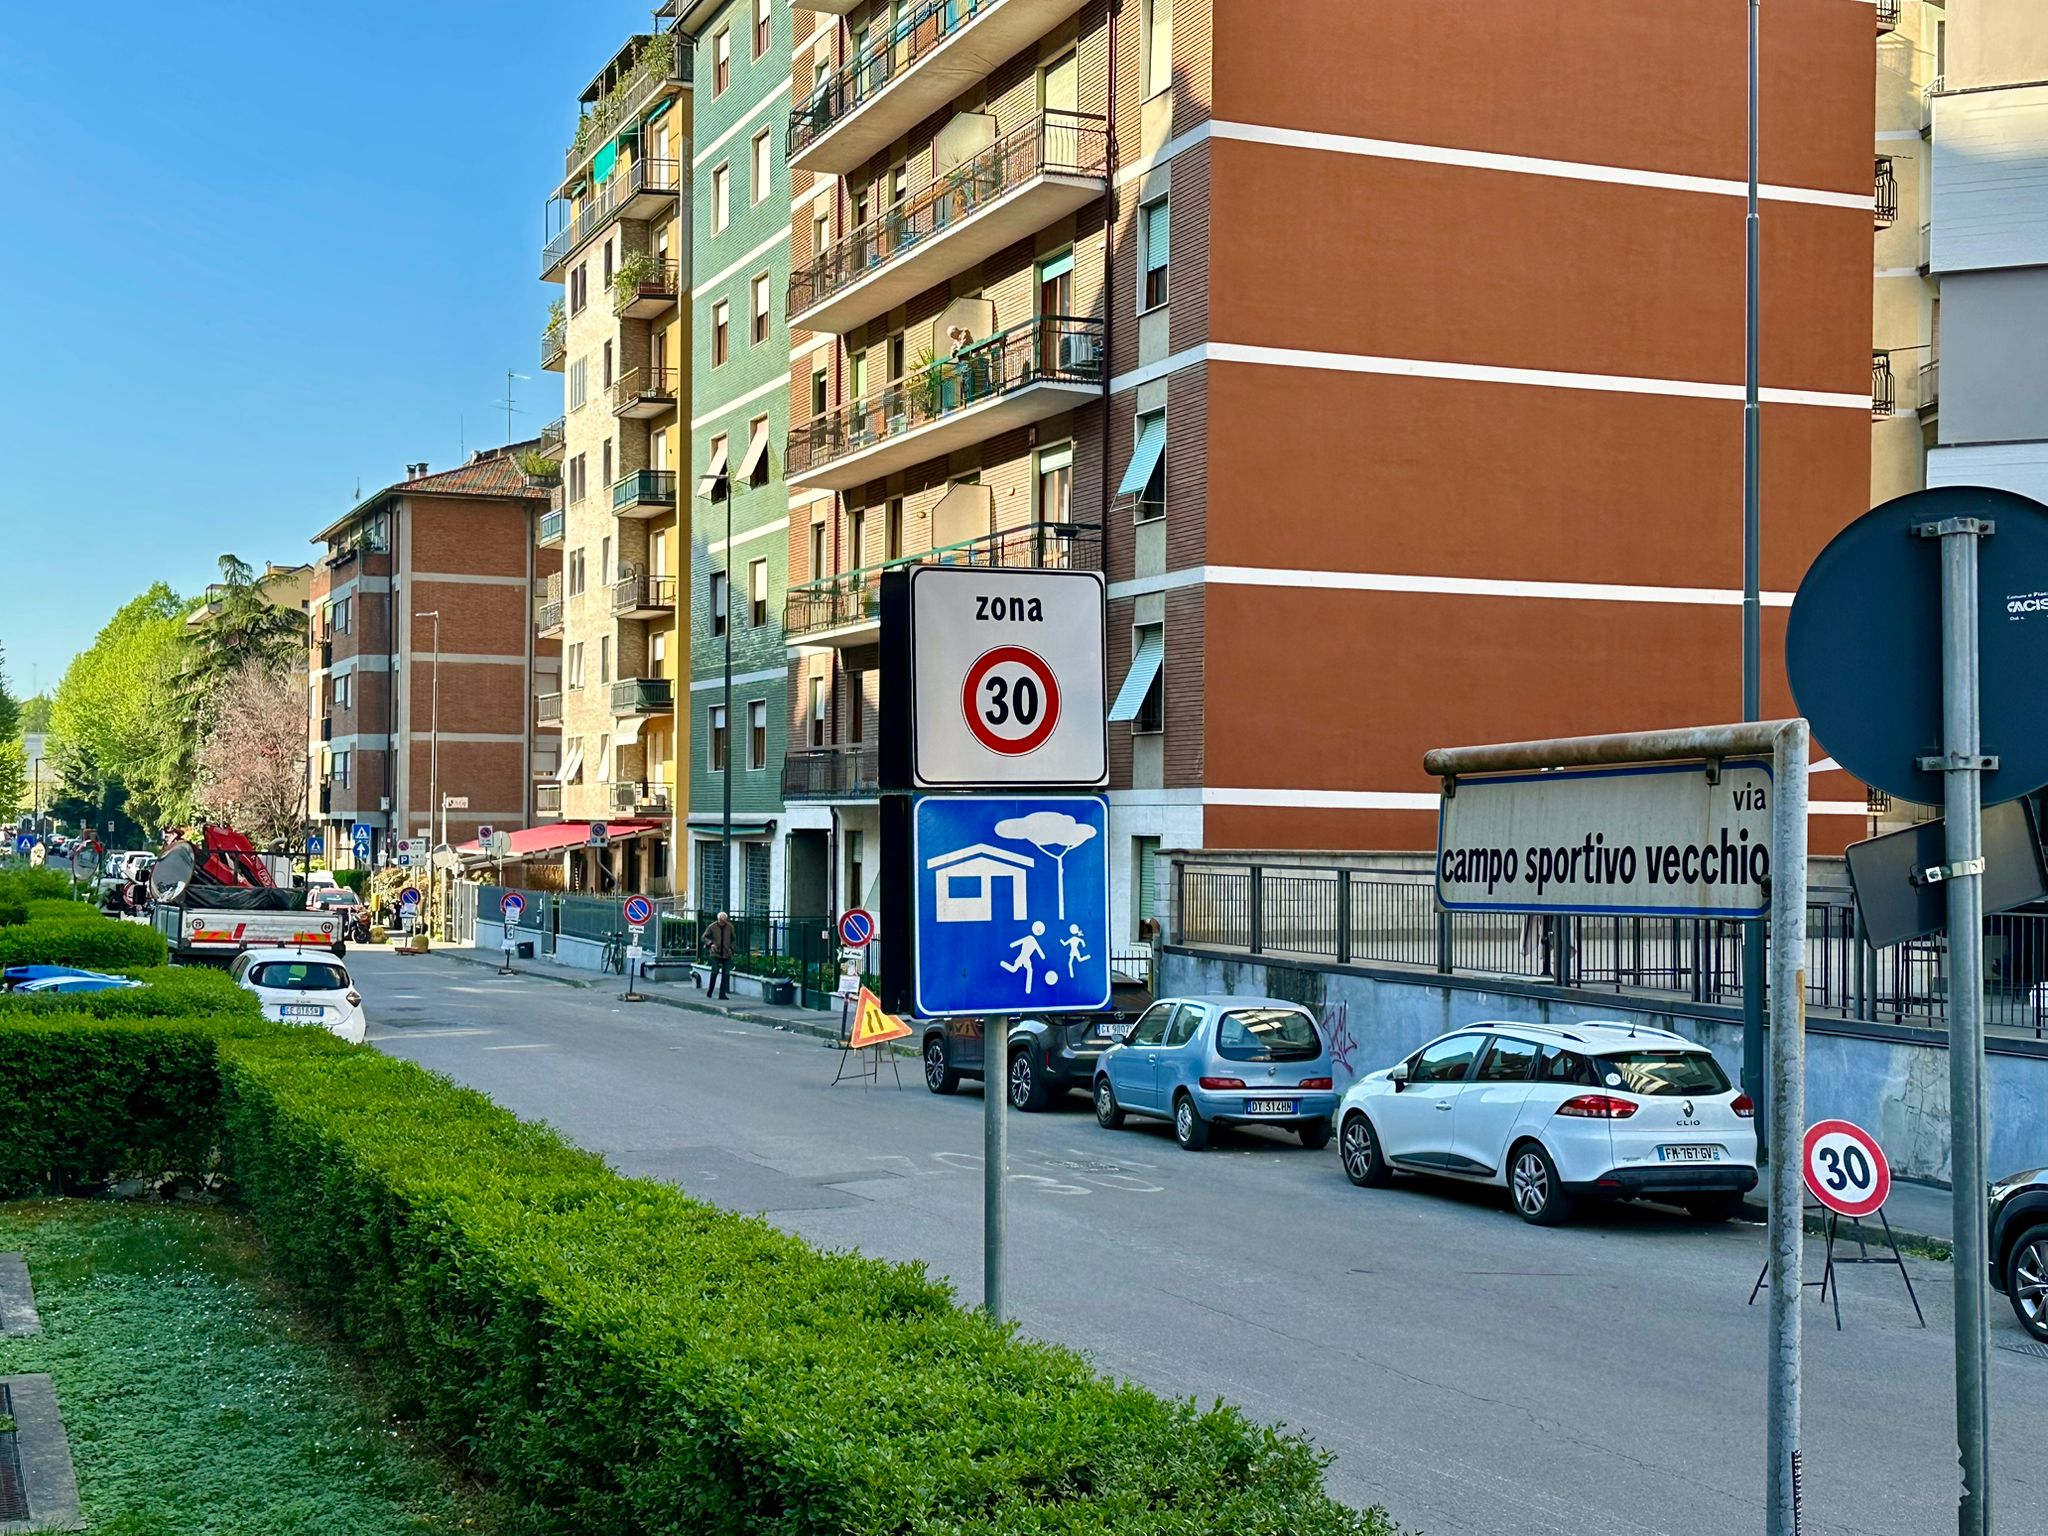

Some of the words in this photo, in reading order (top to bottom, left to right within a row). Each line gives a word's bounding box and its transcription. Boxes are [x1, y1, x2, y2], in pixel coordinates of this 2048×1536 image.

[976, 597, 1043, 621] zona
[985, 676, 1038, 725] 30
[1733, 782, 1766, 811] via
[1442, 848, 1518, 895] campo
[1525, 832, 1636, 895] sportivo
[1646, 828, 1771, 885] vecchio
[1252, 1102, 1262, 1111] DY
[1819, 1145, 1870, 1190] 30
